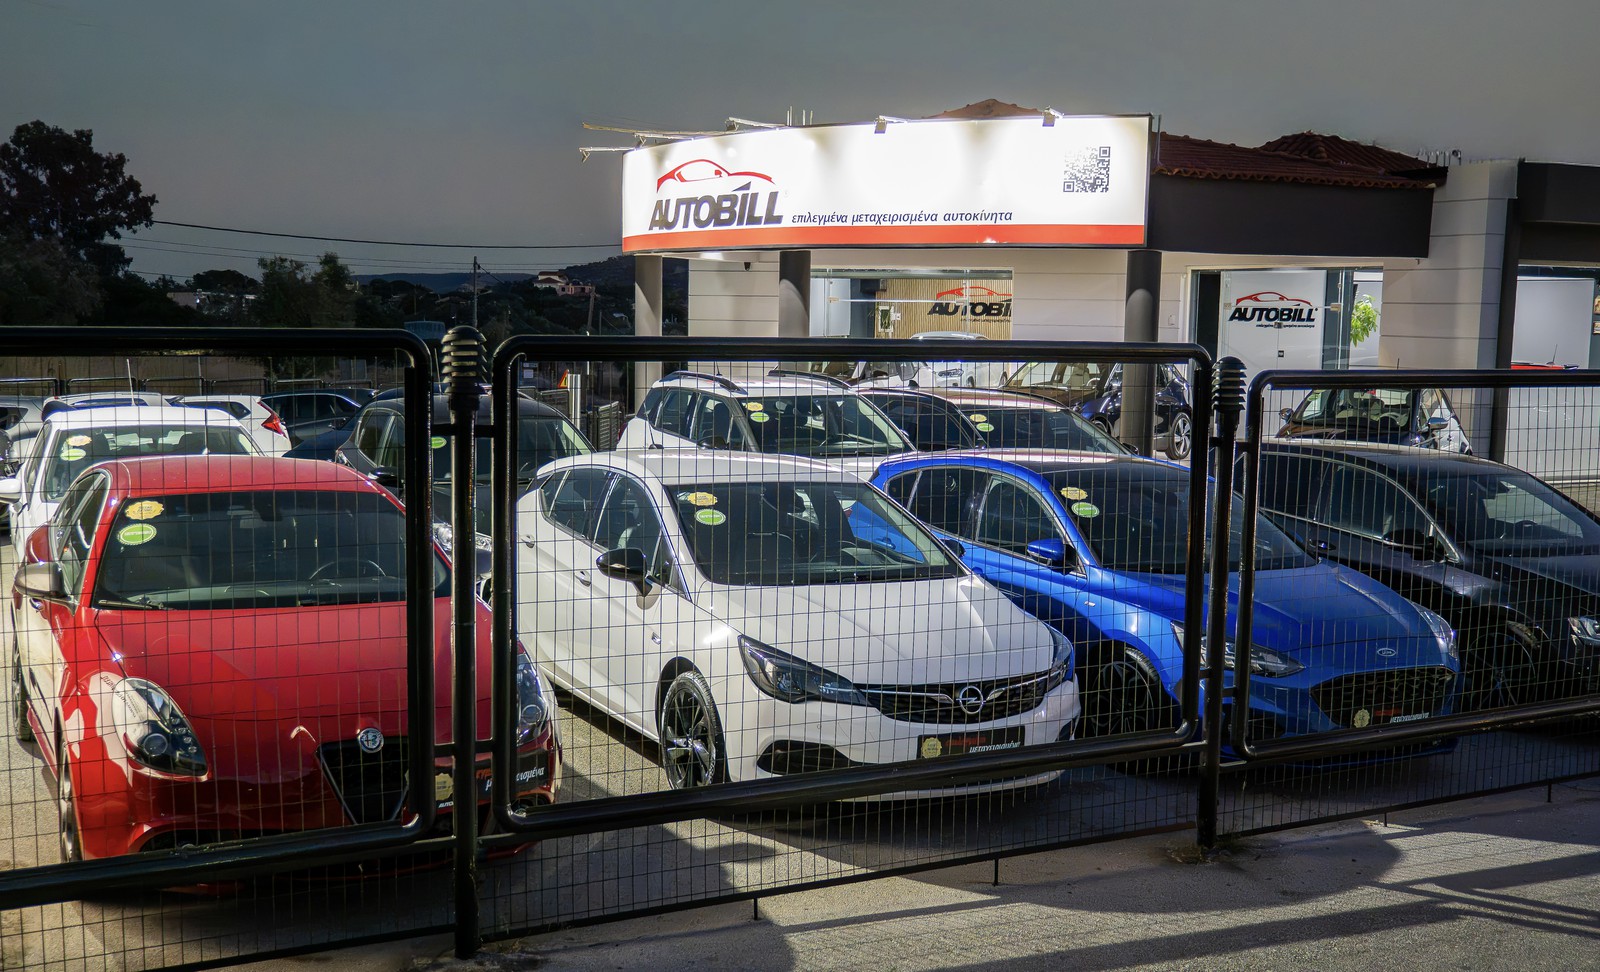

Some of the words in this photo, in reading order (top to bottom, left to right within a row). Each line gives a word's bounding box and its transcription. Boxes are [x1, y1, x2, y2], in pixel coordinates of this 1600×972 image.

[648, 182, 784, 231] AUTOBILL
[791, 211, 849, 226] επιλεγμένα
[851, 210, 939, 226] μεταχειρισμένα
[942, 209, 1014, 224] αυτοκίνητα
[1228, 304, 1316, 323] AUTOBILL
